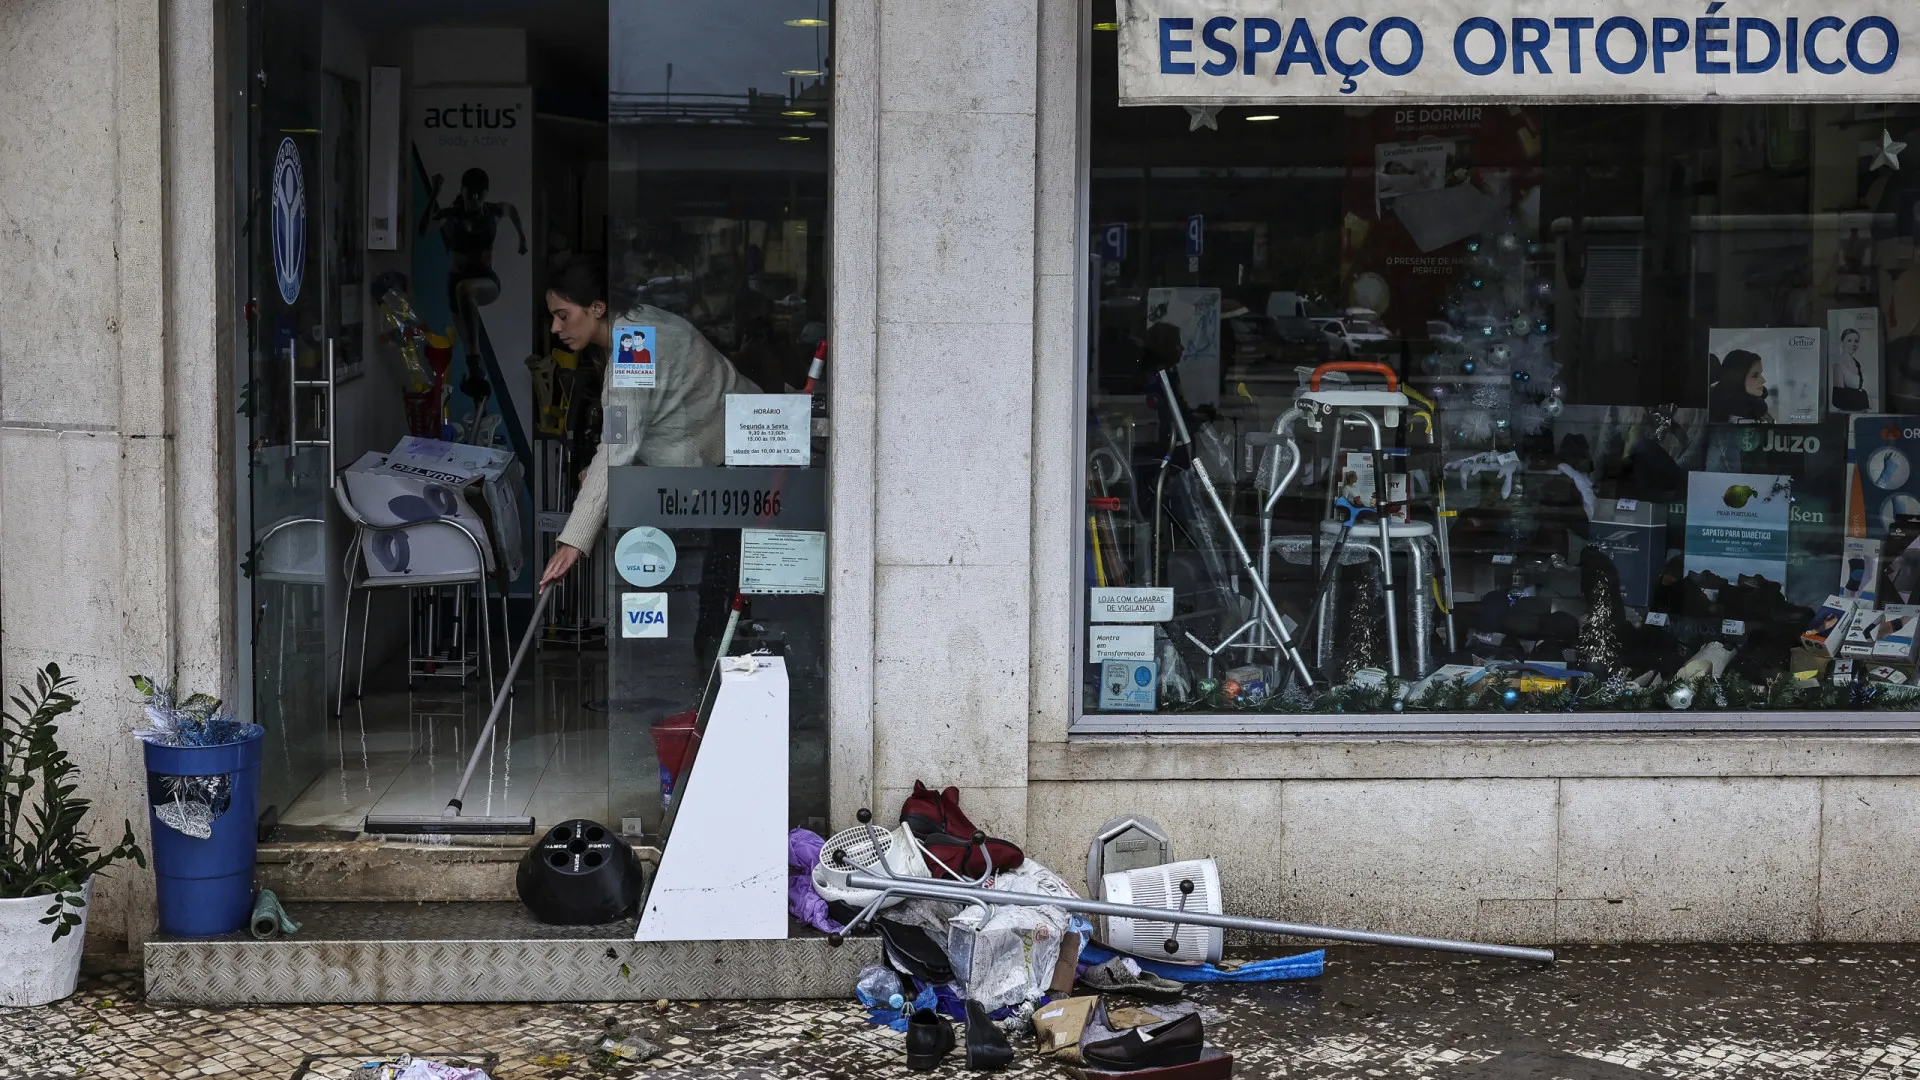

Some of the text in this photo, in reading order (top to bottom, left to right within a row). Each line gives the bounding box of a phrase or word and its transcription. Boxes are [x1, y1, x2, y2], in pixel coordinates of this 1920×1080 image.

[1158, 1, 1900, 95] ESPAÇO ORTOPÉDICO
[424, 102, 517, 129] actius
[1394, 107, 1482, 124] DE DORMIR
[1385, 256, 1392, 265] O
[1394, 256, 1437, 265] PRESENTE
[1438, 256, 1449, 265] DE
[1412, 265, 1453, 275] PERFEITO
[753, 407, 781, 415] HORÁRIO
[1903, 427, 1920, 439] OR
[1762, 428, 1821, 454] Juzo
[657, 488, 781, 516] Tel.: 211 919 866
[1789, 505, 1824, 523] ßen
[1701, 528, 1772, 540] SAPATO PARA DIABÉTICO
[1098, 595, 1165, 603] LOJA COM CAMARAS
[1106, 604, 1156, 612] DE VIGILANCIA
[627, 610, 665, 624] VISA
